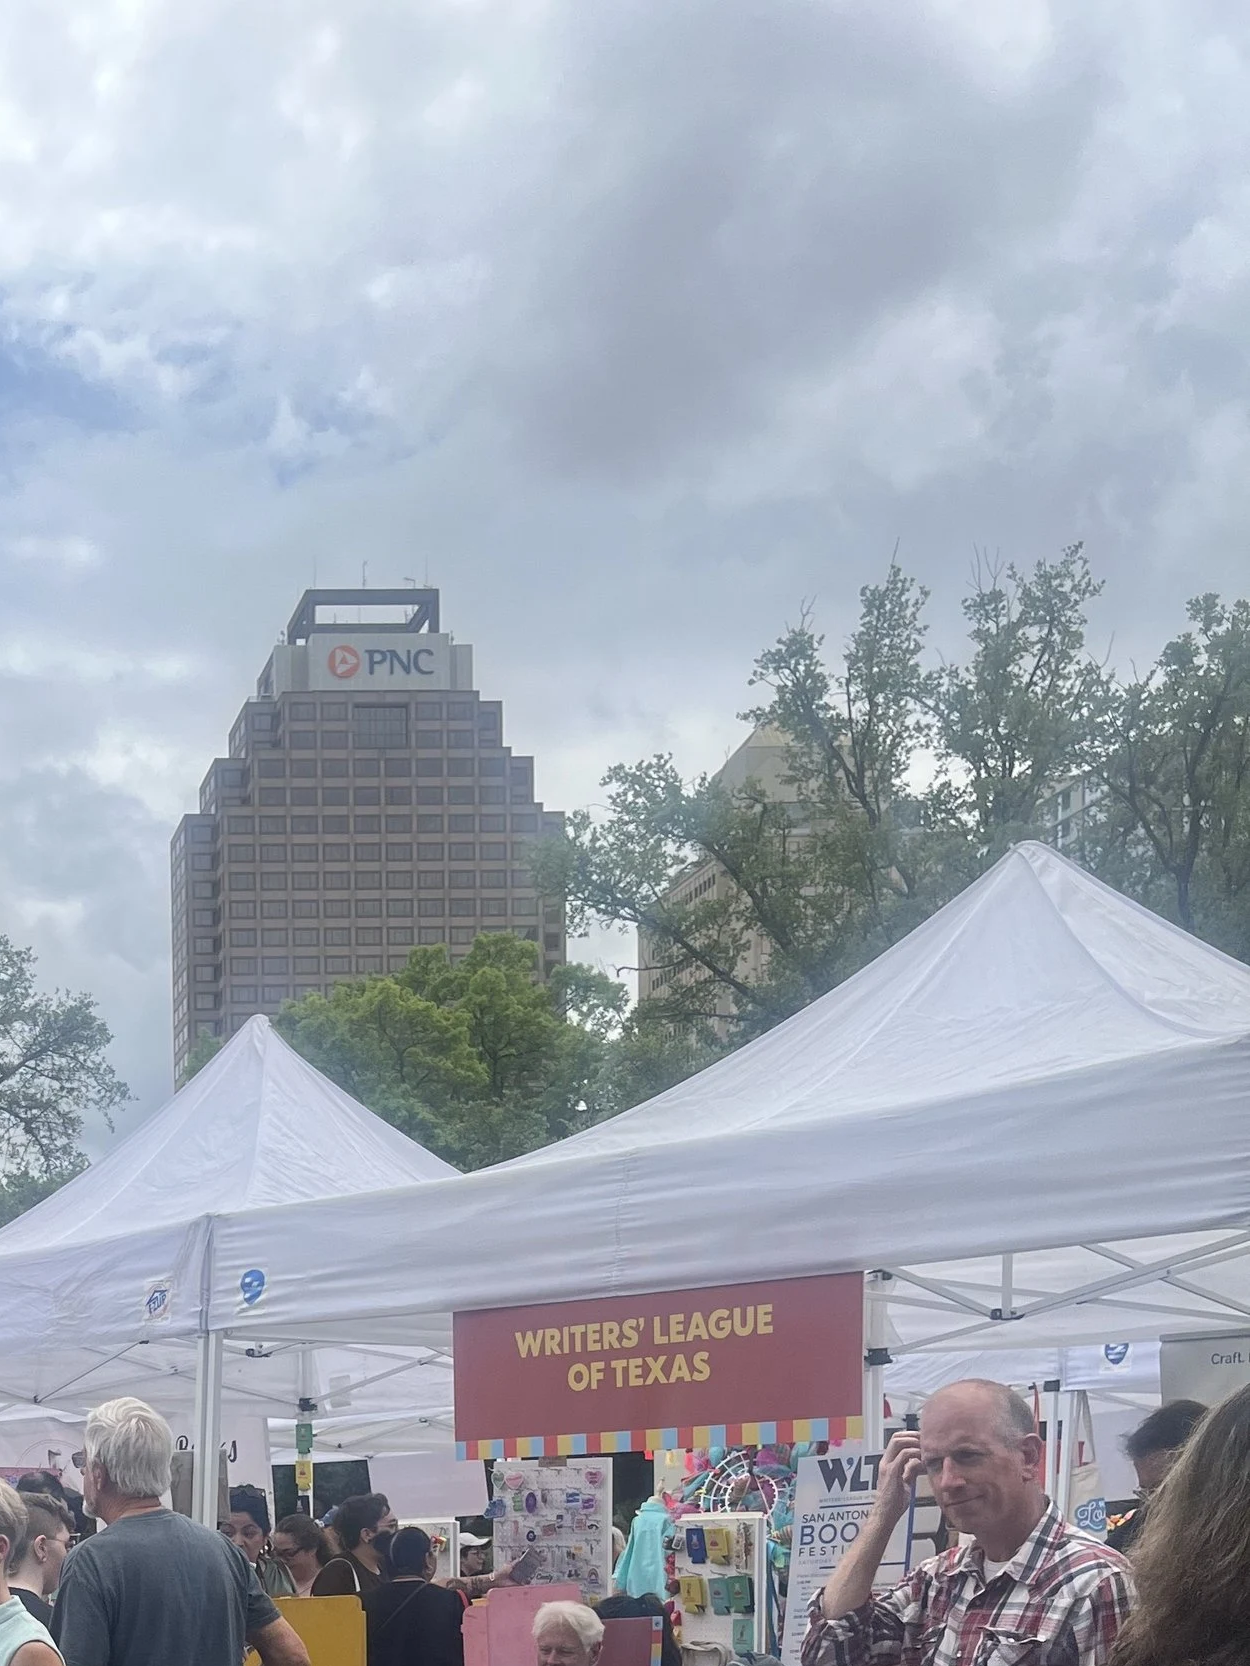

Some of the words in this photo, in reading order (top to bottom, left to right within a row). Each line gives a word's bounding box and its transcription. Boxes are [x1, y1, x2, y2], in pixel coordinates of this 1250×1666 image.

[364, 648, 435, 675] PNC
[515, 1317, 645, 1358] WRITERS'
[653, 1303, 774, 1345] LEAGUE
[567, 1362, 605, 1392] OF
[611, 1351, 711, 1388] TEXAS
[802, 1513, 825, 1523] SAN
[828, 1509, 869, 1521] ANTON
[800, 1522, 860, 1545] BOO
[798, 1545, 845, 1557] FESTI
